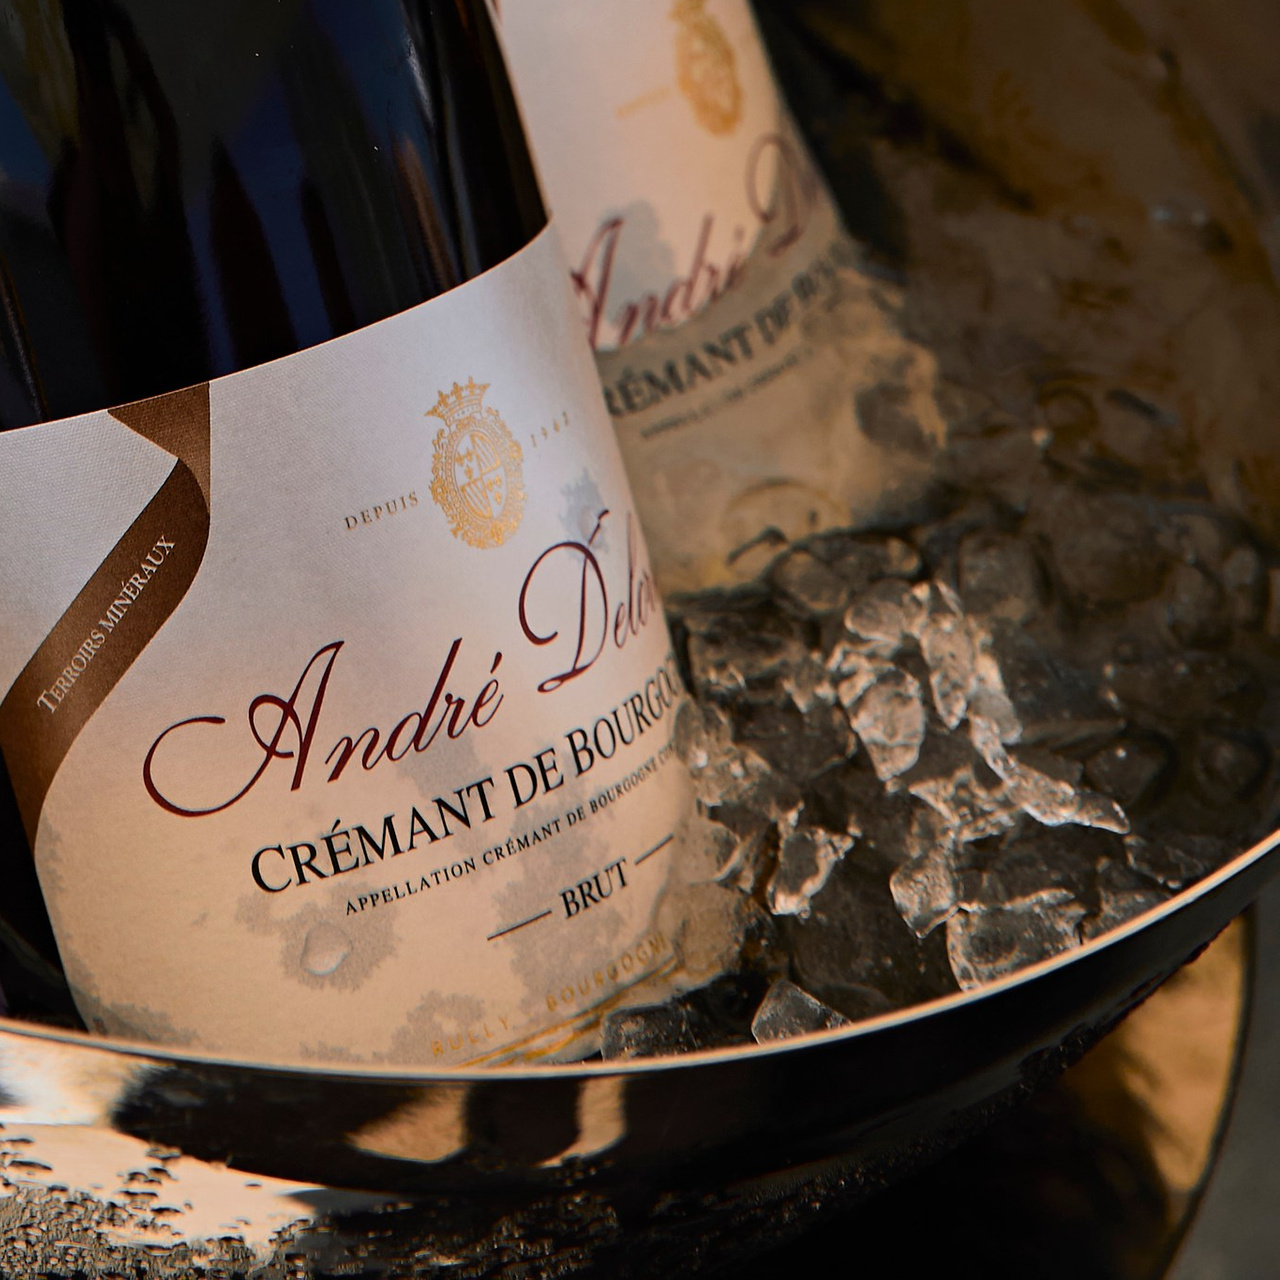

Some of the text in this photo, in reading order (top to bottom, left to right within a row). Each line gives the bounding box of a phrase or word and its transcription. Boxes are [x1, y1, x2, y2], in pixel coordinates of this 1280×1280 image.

[601, 323, 754, 418] RÉMANT
[343, 490, 419, 531] DEPUIS
[36, 534, 176, 714] TERROIRS MINÉRAUX
[142, 636, 505, 819] André
[250, 776, 496, 894] CRÉMANT
[505, 747, 566, 809] DE
[345, 756, 658, 917] APPELLATION CRÉMANT DE BOURGOGNE
[559, 857, 631, 920] BRUT
[545, 930, 667, 1013] BOURGOGN
